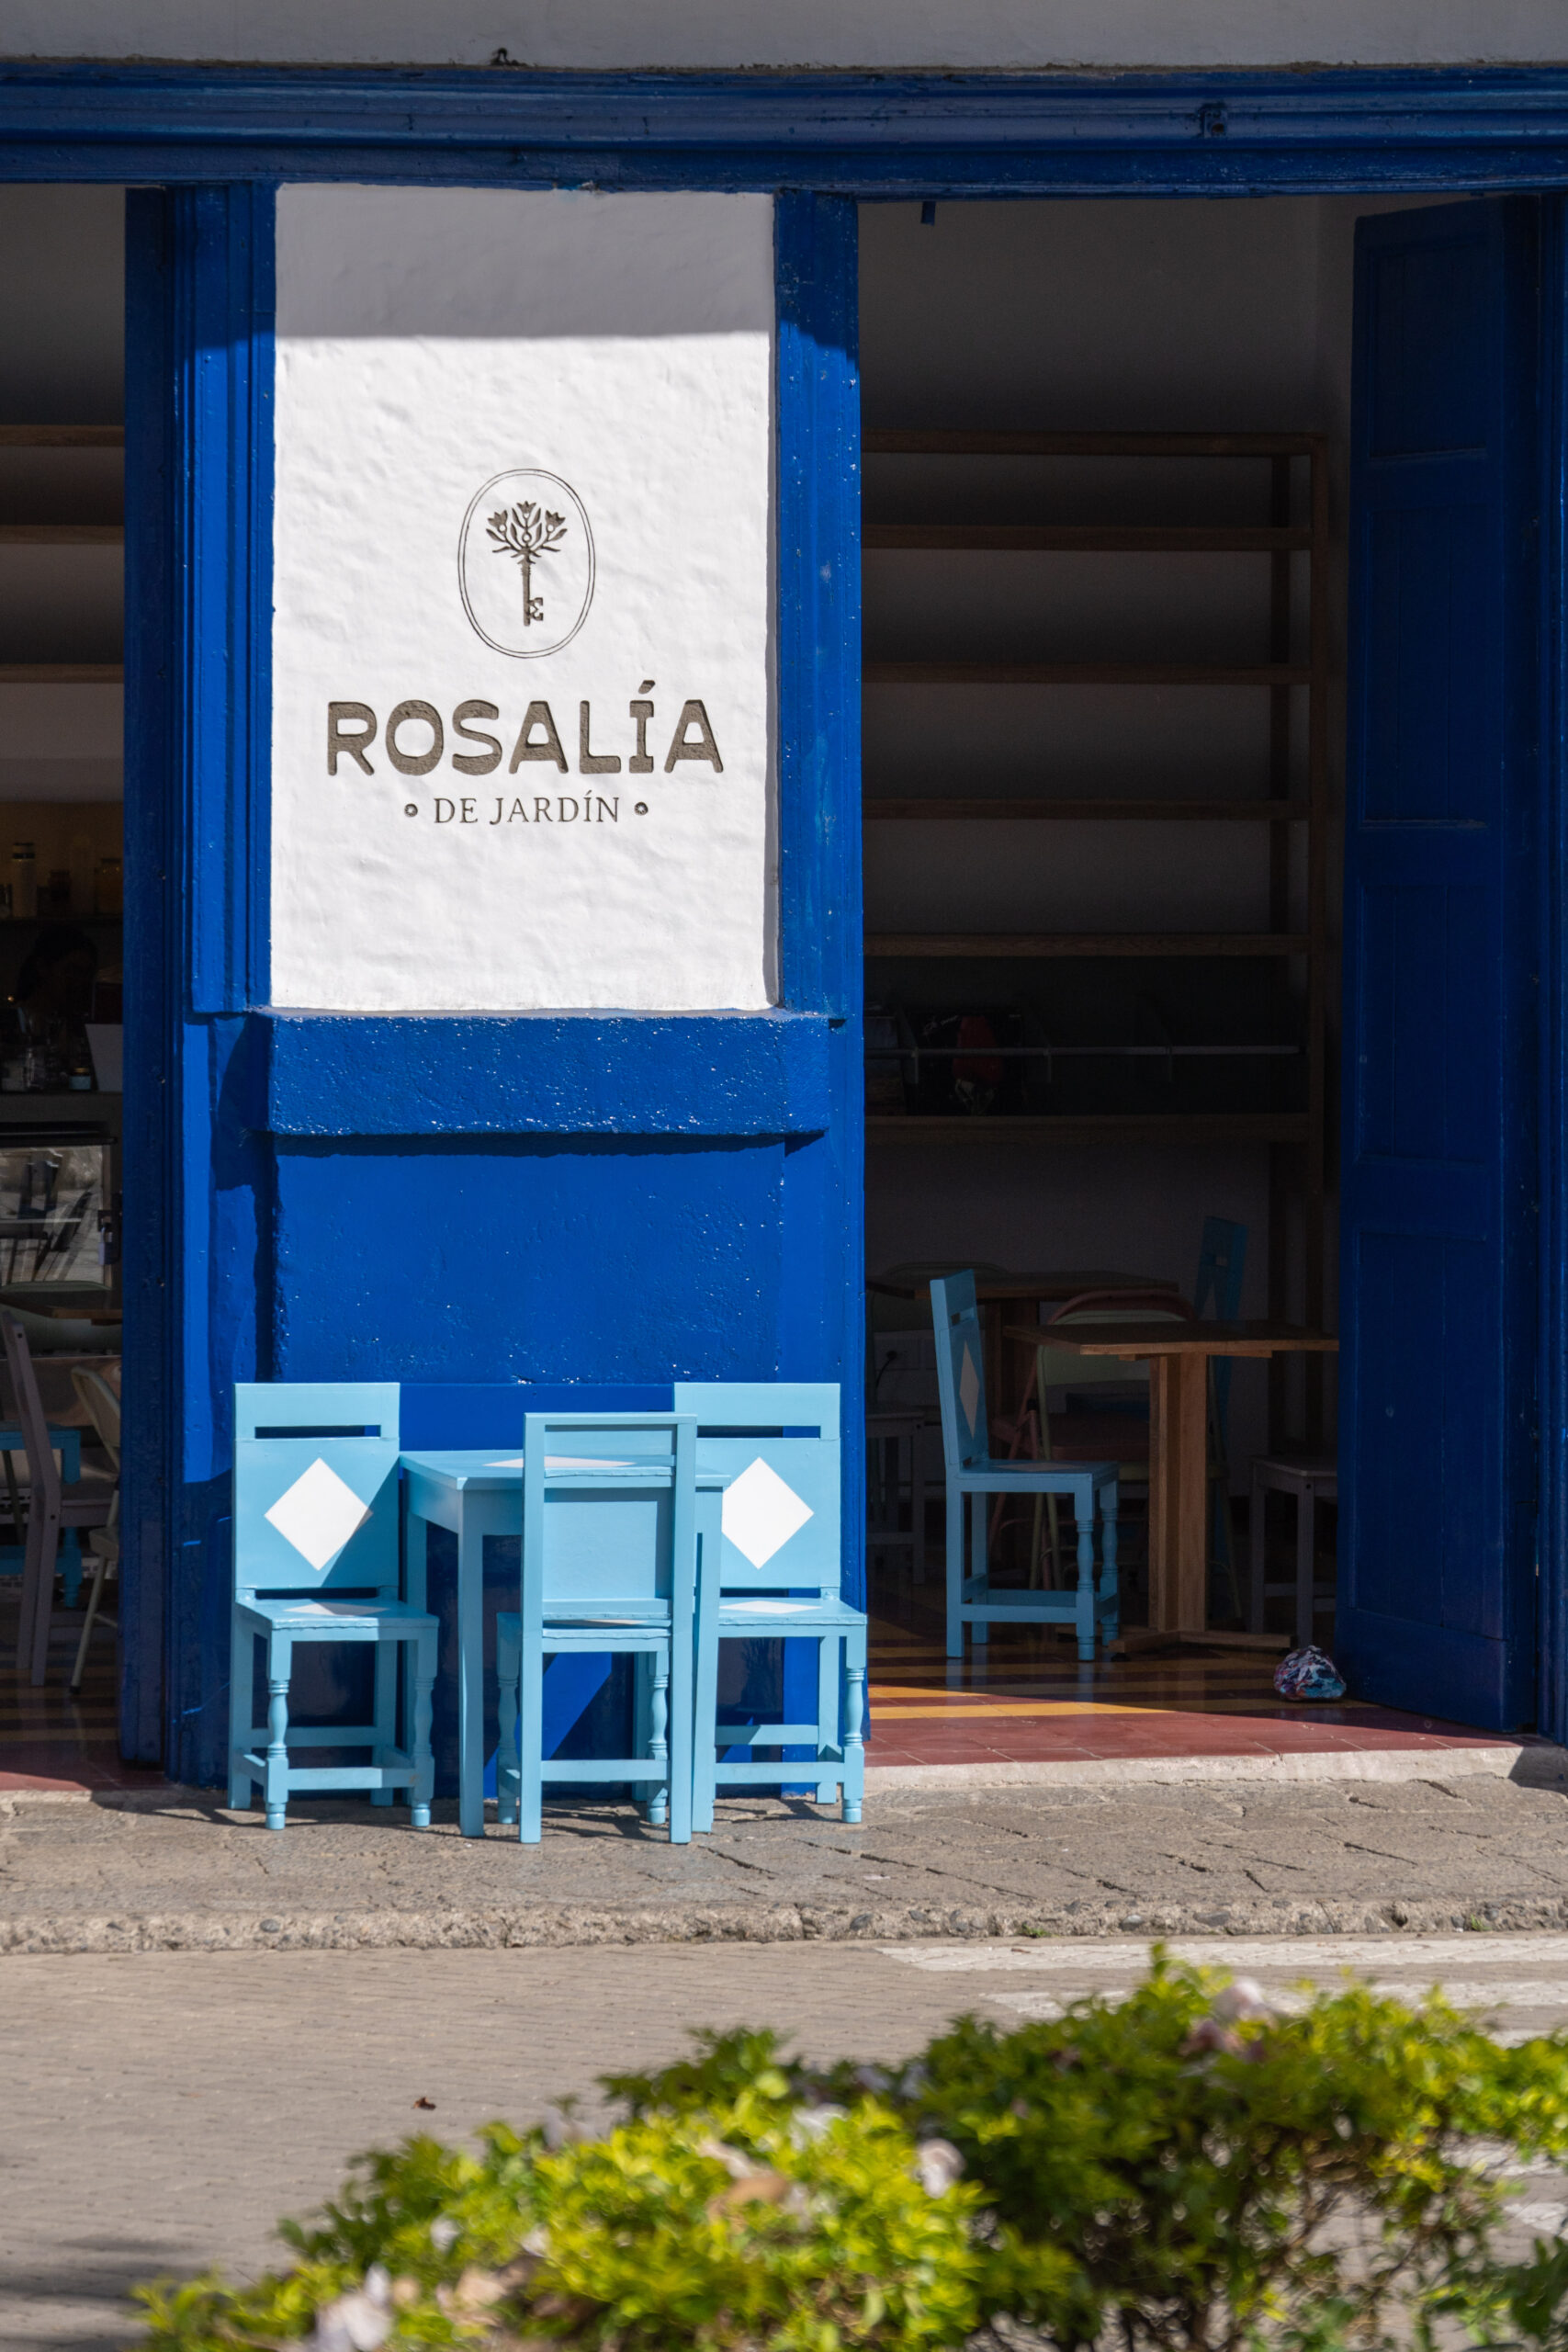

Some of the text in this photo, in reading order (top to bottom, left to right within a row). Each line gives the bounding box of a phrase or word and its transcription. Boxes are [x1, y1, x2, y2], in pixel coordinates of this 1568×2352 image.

[327, 679, 724, 776] ROSALÍA
[433, 789, 620, 825] DE JARDÍN
